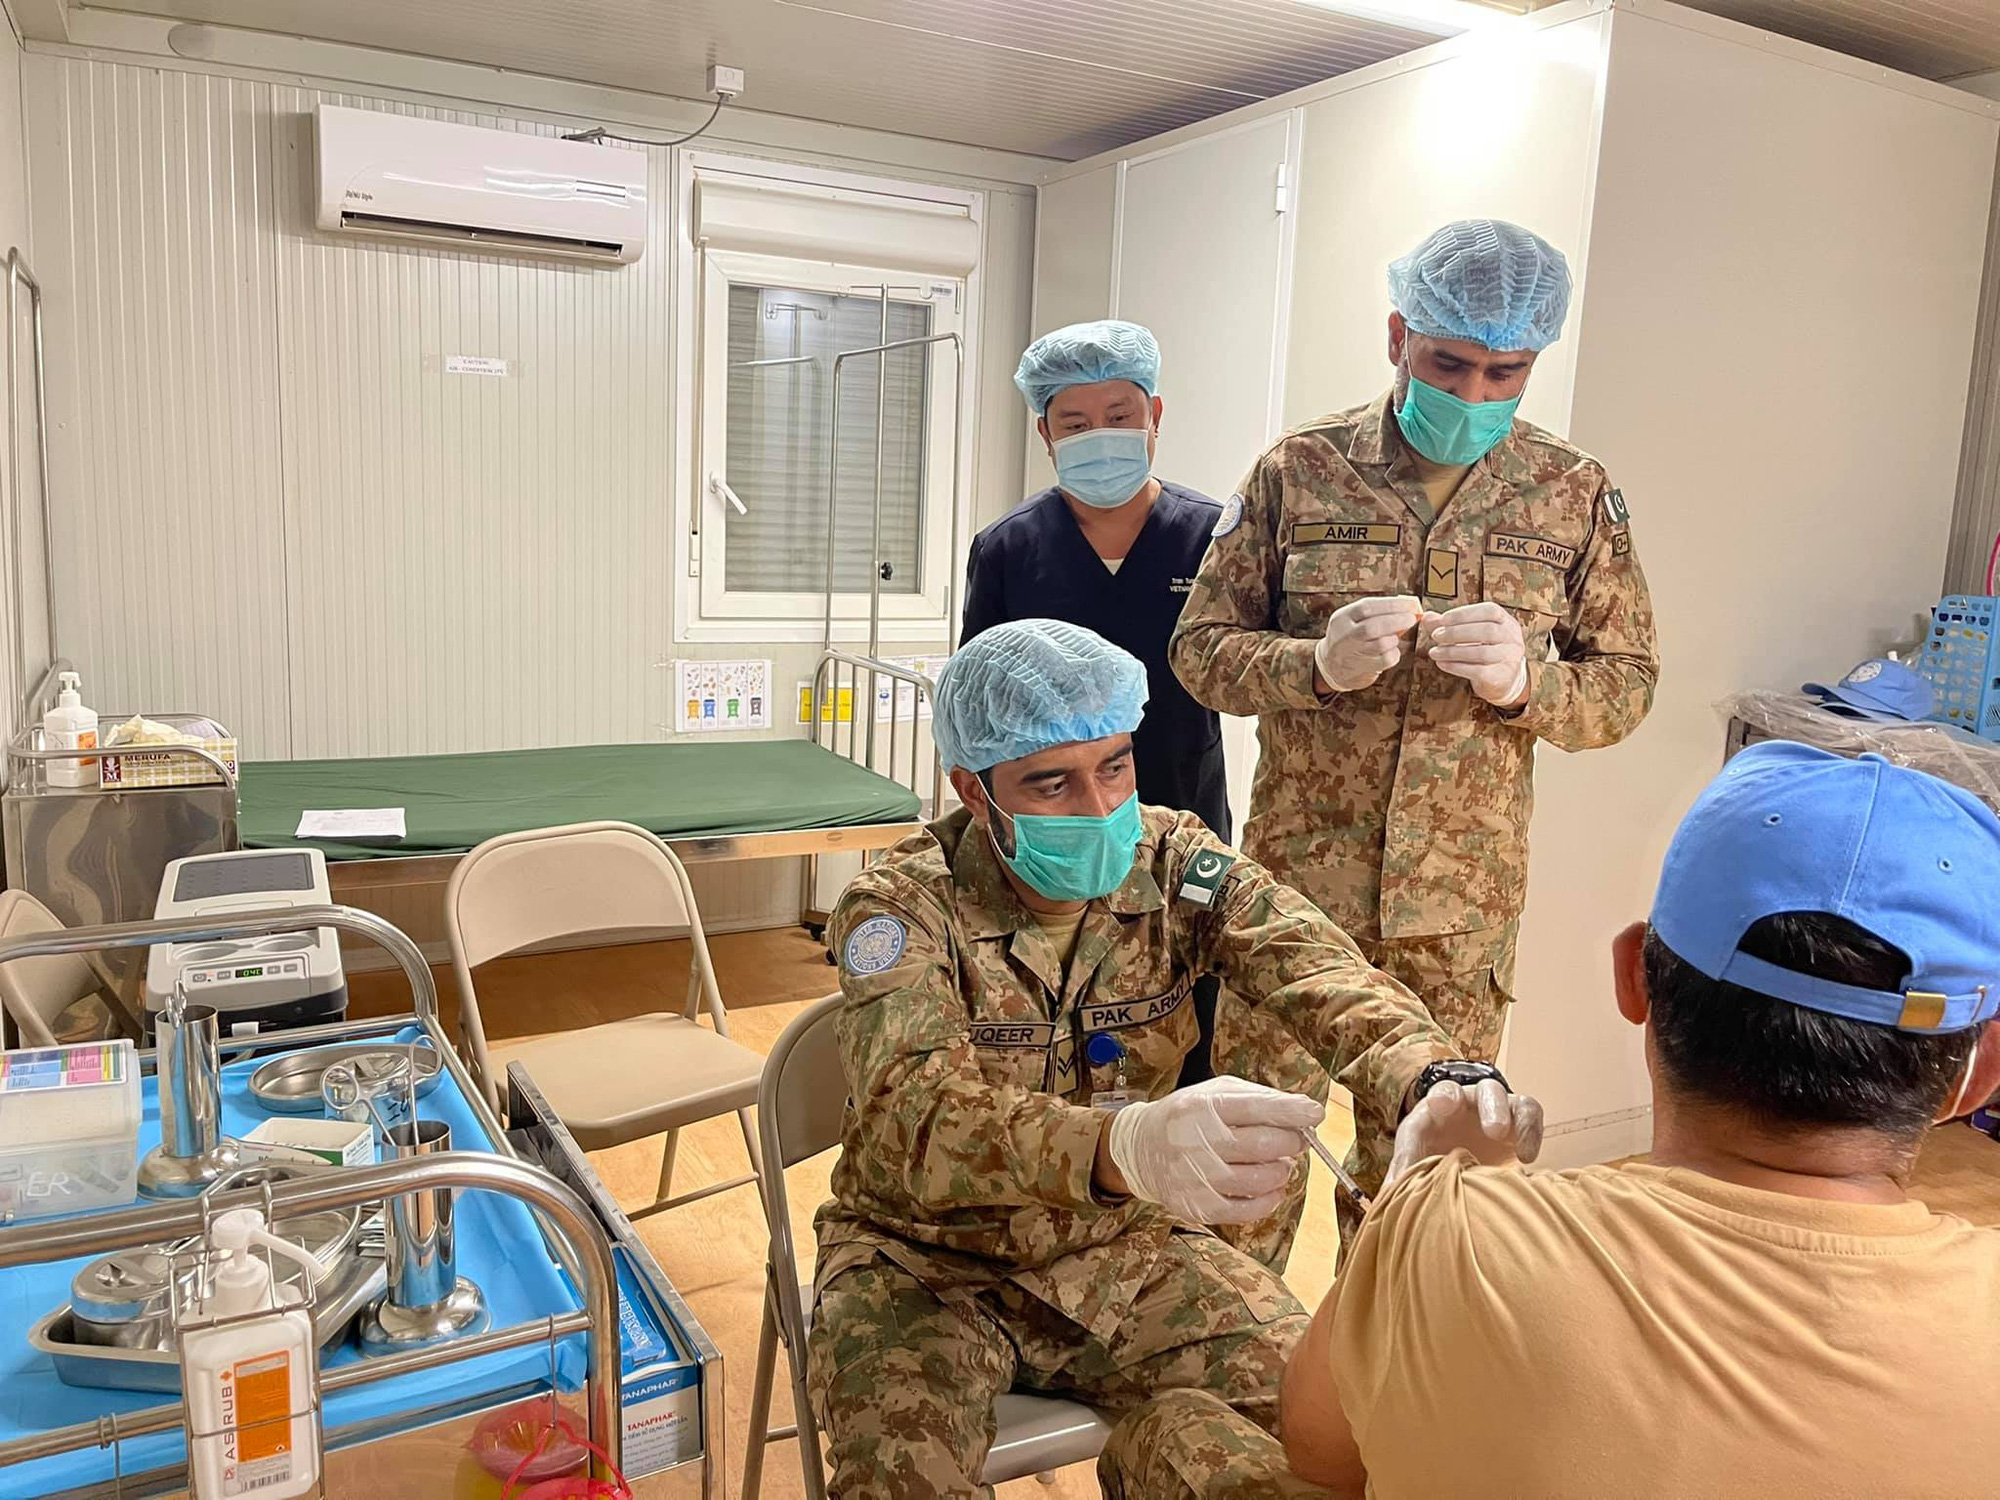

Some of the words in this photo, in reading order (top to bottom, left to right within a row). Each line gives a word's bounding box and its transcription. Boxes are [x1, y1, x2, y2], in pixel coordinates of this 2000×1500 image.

[1324, 526, 1368, 540] AMIR
[1496, 538, 1529, 554] PAK
[1536, 544, 1571, 564] ARMY
[1092, 1007, 1133, 1028] PAK
[1148, 979, 1187, 1018] ARMY
[27, 1171, 71, 1197] ER
[221, 1386, 236, 1460] ASRUB
